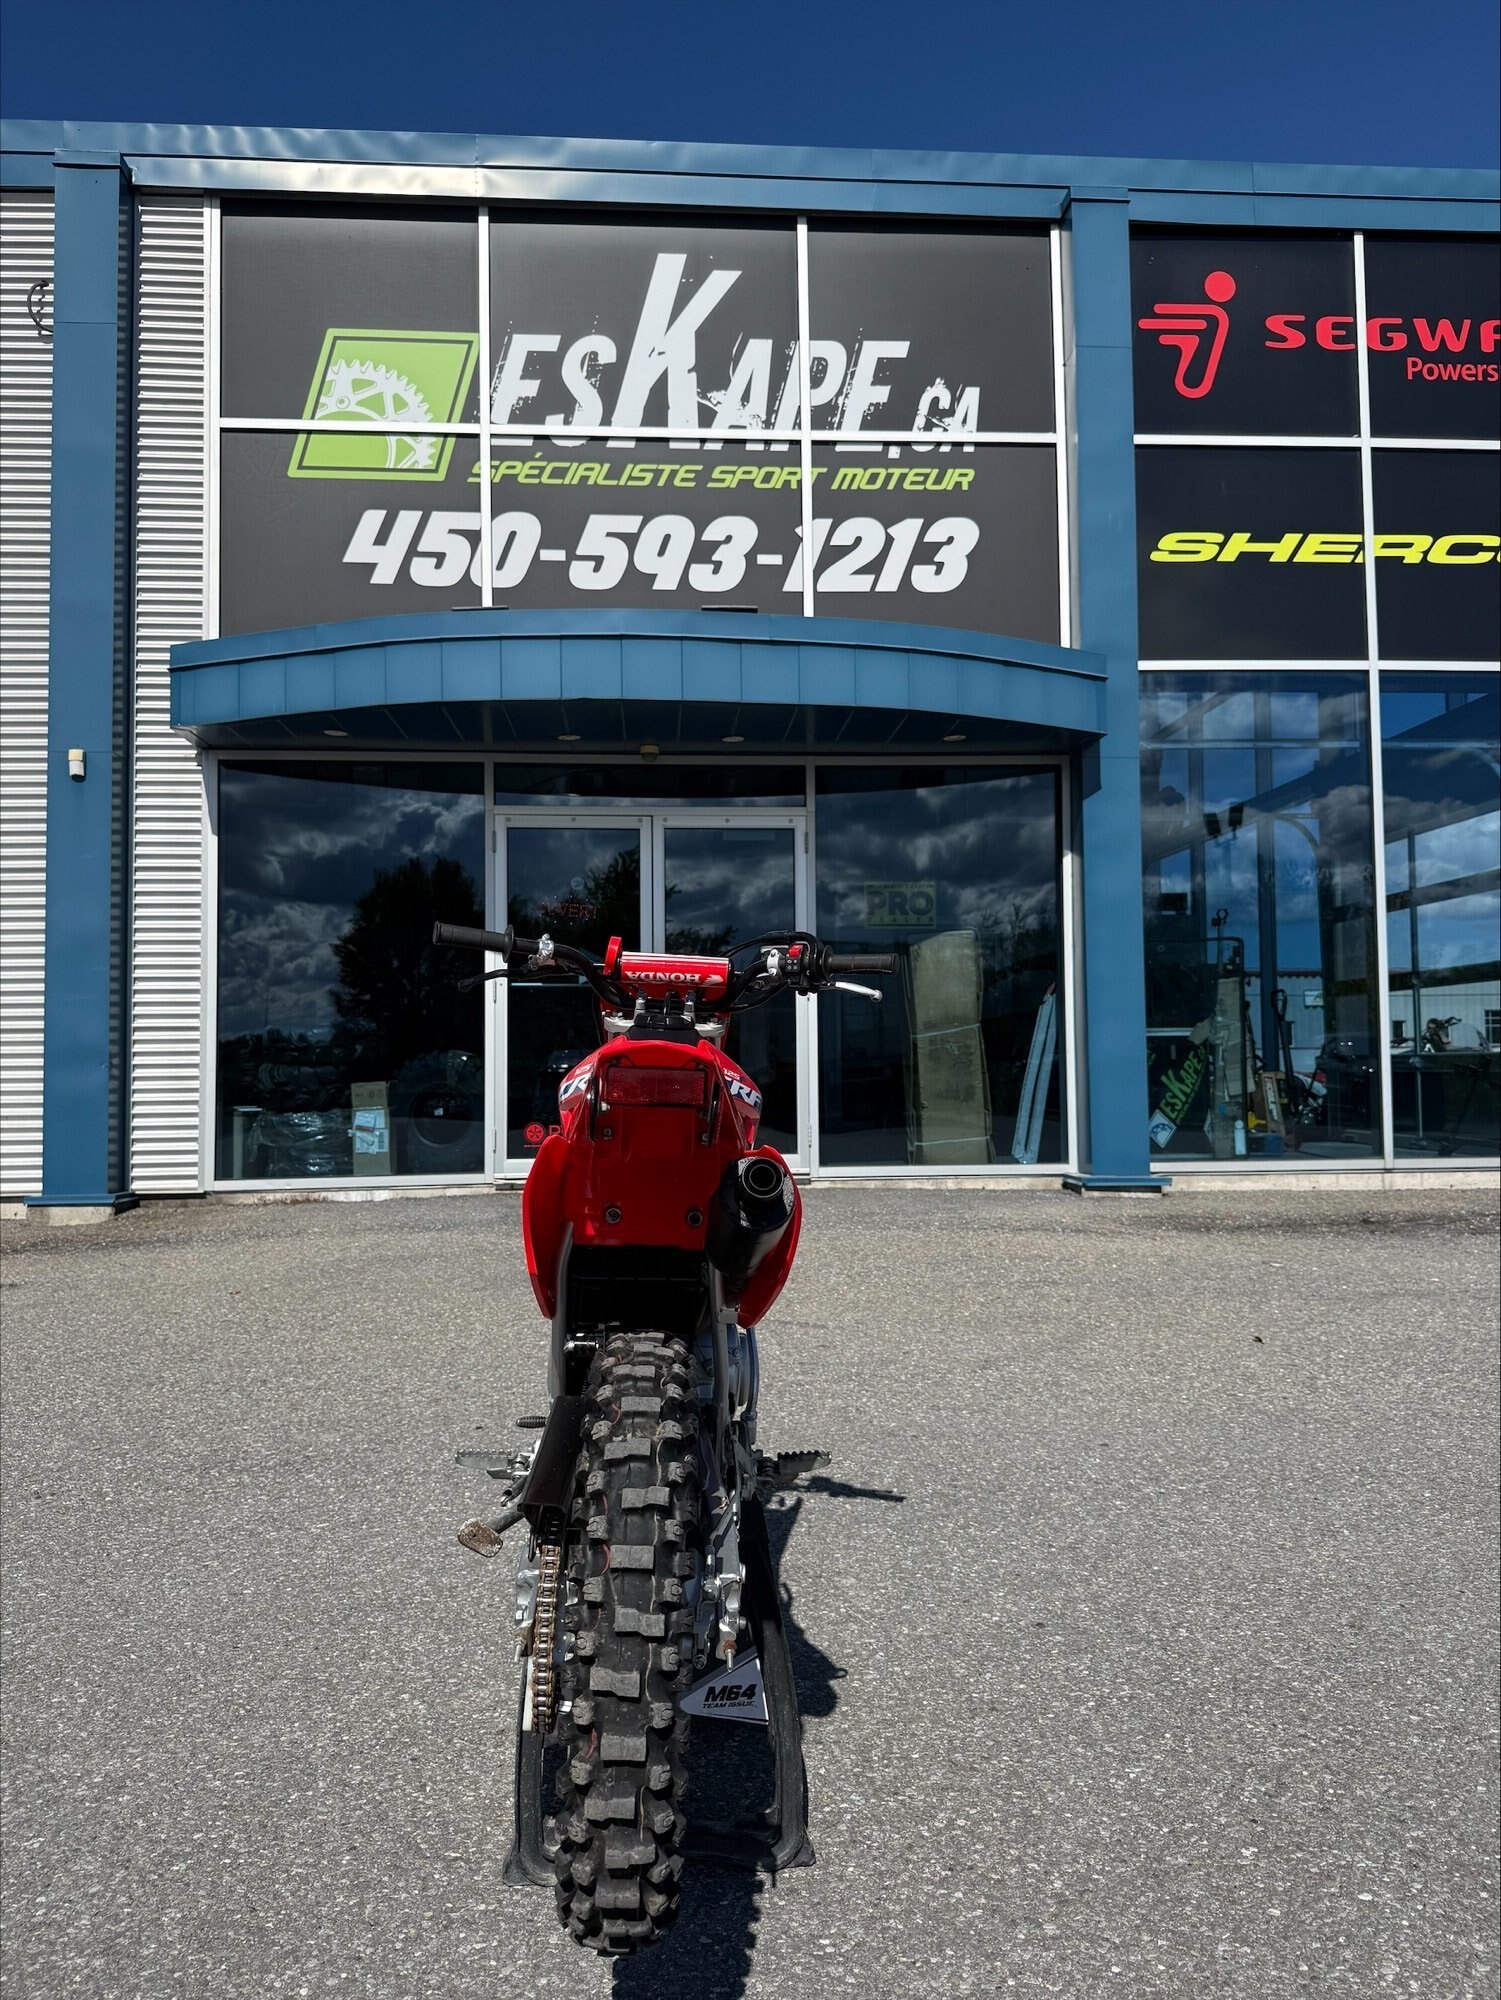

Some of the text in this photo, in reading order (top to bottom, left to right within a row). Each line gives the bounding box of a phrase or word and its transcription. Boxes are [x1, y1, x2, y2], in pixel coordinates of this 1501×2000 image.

[1406, 357, 1499, 382] Powers
[467, 452, 703, 488] SPÉCIALISTE
[831, 467, 975, 491] MOTEUR
[342, 509, 980, 593] 450-593-1213
[1149, 532, 1500, 565] SHERC
[867, 890, 934, 916] PRO
[624, 970, 702, 984] HONDA
[704, 1683, 757, 1702] M64
